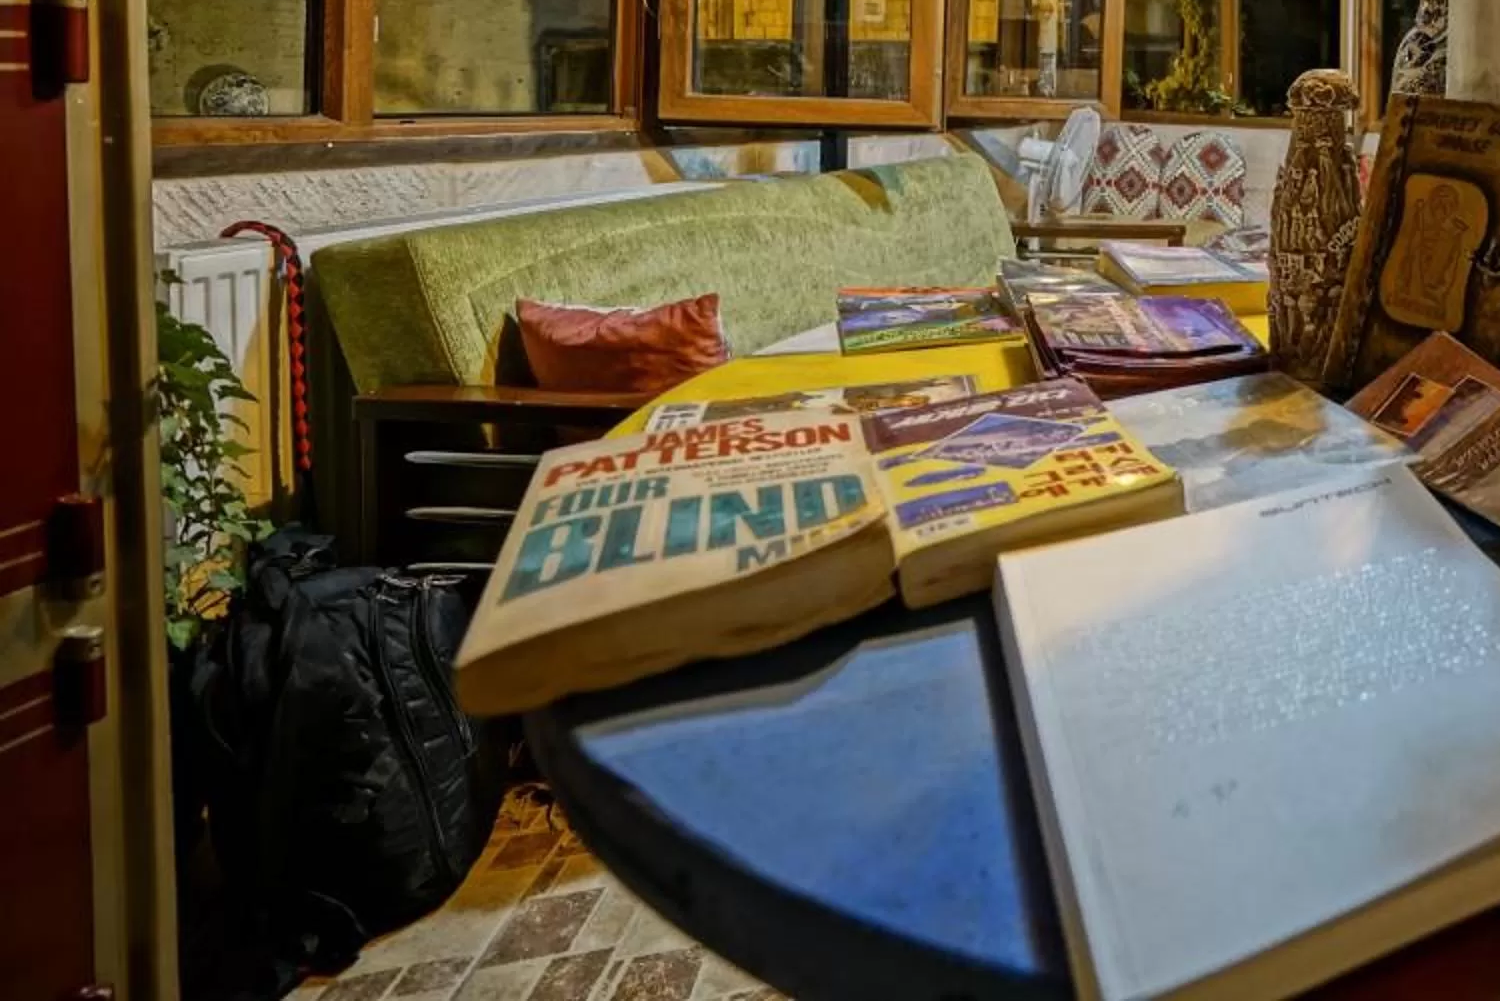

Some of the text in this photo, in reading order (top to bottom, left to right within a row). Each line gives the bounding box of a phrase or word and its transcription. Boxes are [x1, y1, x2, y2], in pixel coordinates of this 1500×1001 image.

[543, 422, 852, 490] PATTERSON
[637, 415, 764, 455] JAMES
[529, 475, 671, 529] FOUR
[496, 472, 869, 605] BLIND
